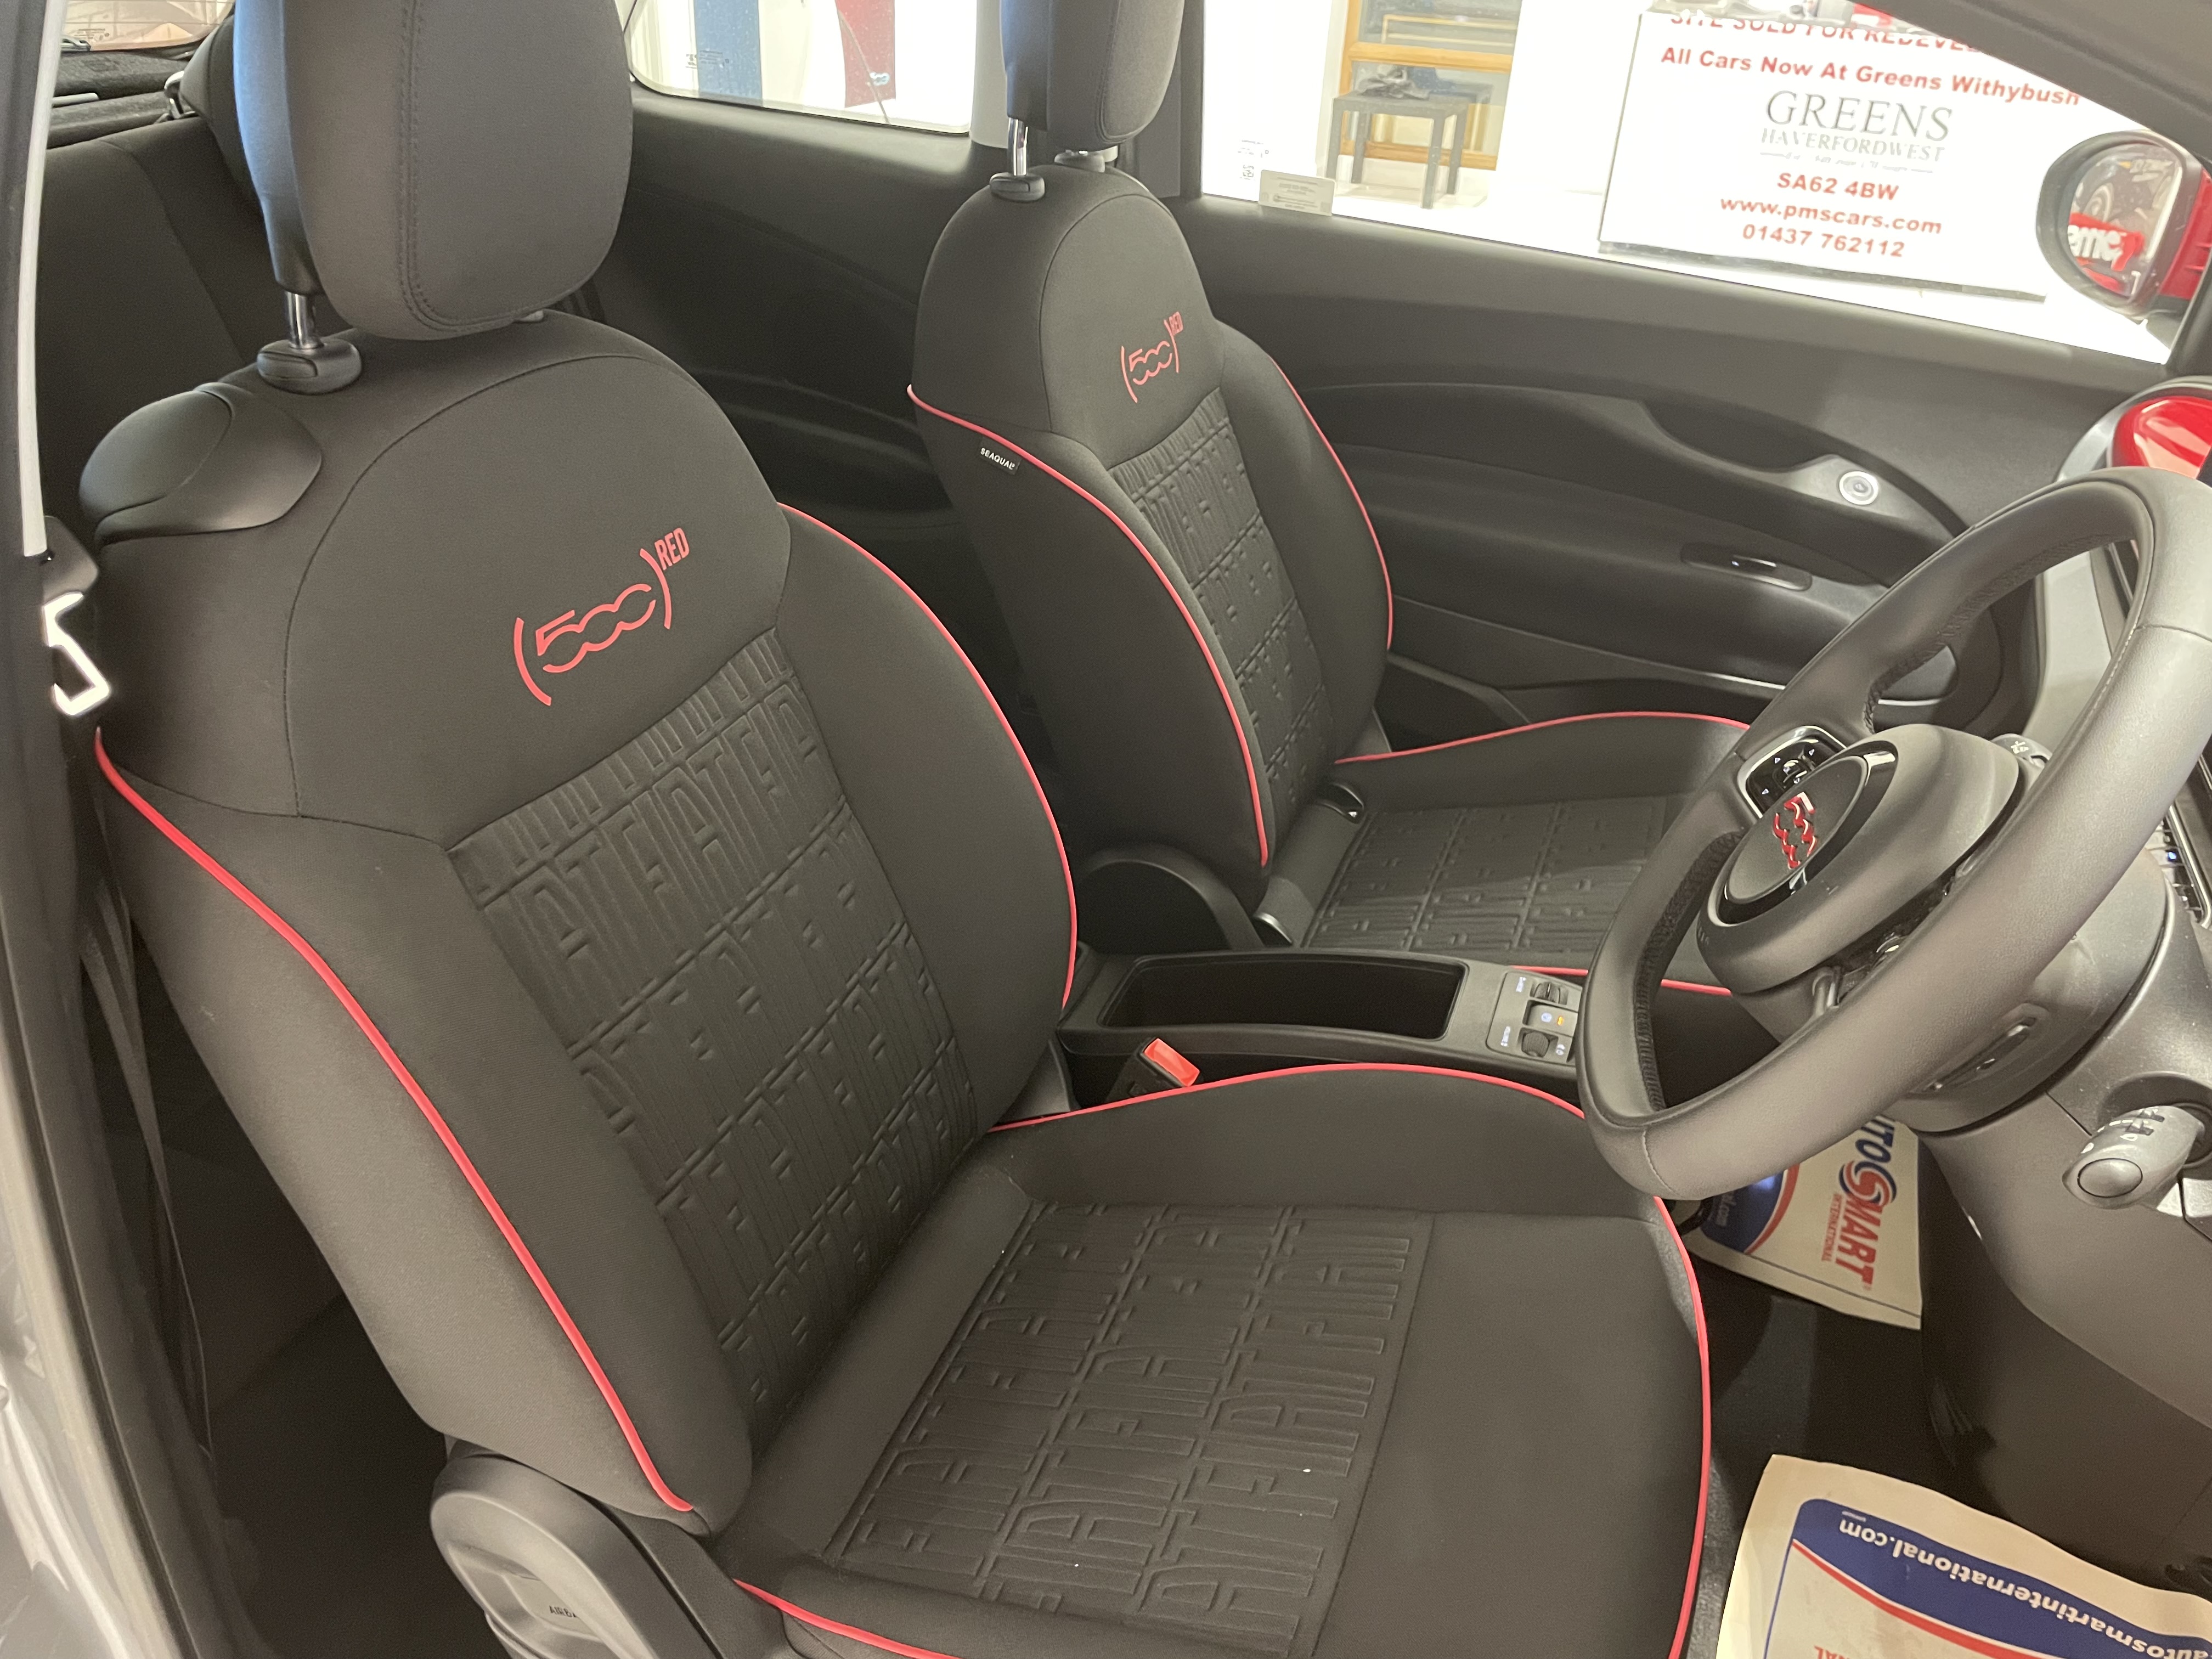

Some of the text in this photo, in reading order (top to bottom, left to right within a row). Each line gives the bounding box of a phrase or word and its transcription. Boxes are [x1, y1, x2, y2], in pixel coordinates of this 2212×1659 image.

[1661, 47, 2081, 105] All Cars Now At Greens Withybush
[1765, 89, 1953, 142] GREENS
[1776, 172, 1899, 200] SA62 4BW
[1720, 198, 1942, 234] www.pmscars.com
[1742, 223, 1905, 257] 01437 762112
[654, 527, 690, 571] RED
